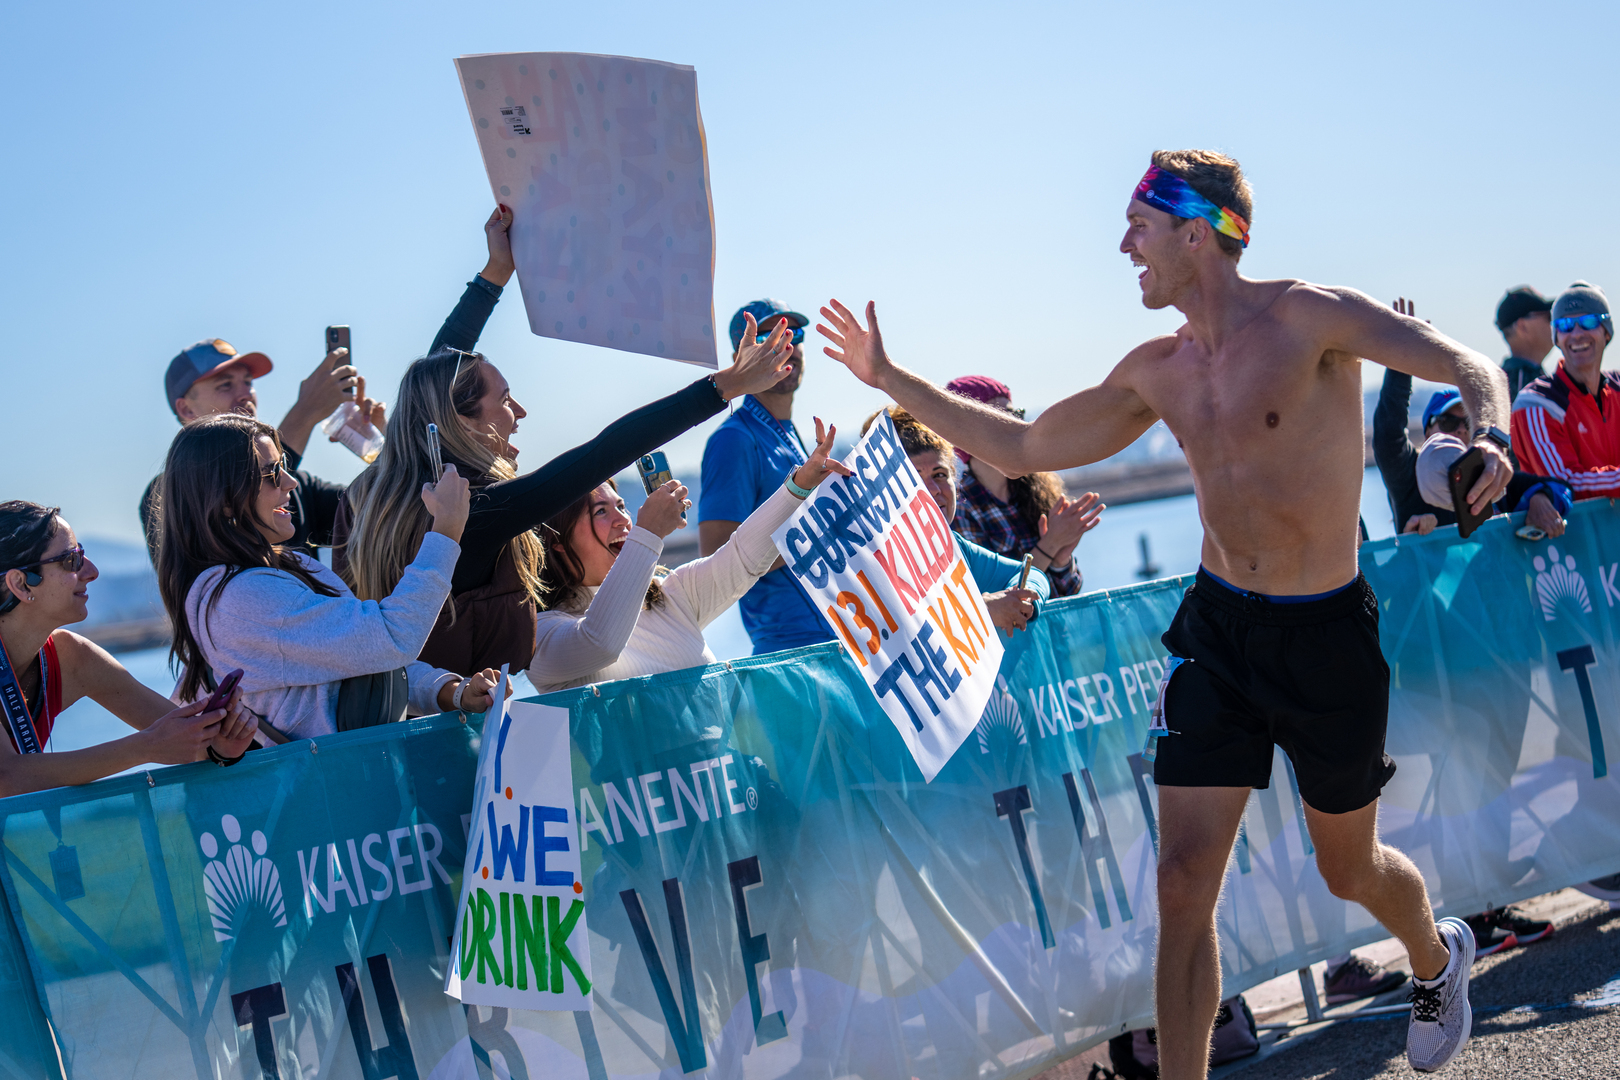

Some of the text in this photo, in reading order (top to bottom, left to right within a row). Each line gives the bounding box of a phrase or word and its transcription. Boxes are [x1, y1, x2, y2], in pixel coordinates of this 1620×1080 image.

[786, 415, 918, 590] CURIOSITY
[826, 489, 954, 668] 13.1 KILLED
[5, 686, 21, 711] HALF
[873, 558, 990, 733] THE KAT
[1028, 671, 1123, 739] KAISER
[297, 822, 454, 919] KAISER
[460, 887, 592, 997] DRINK
